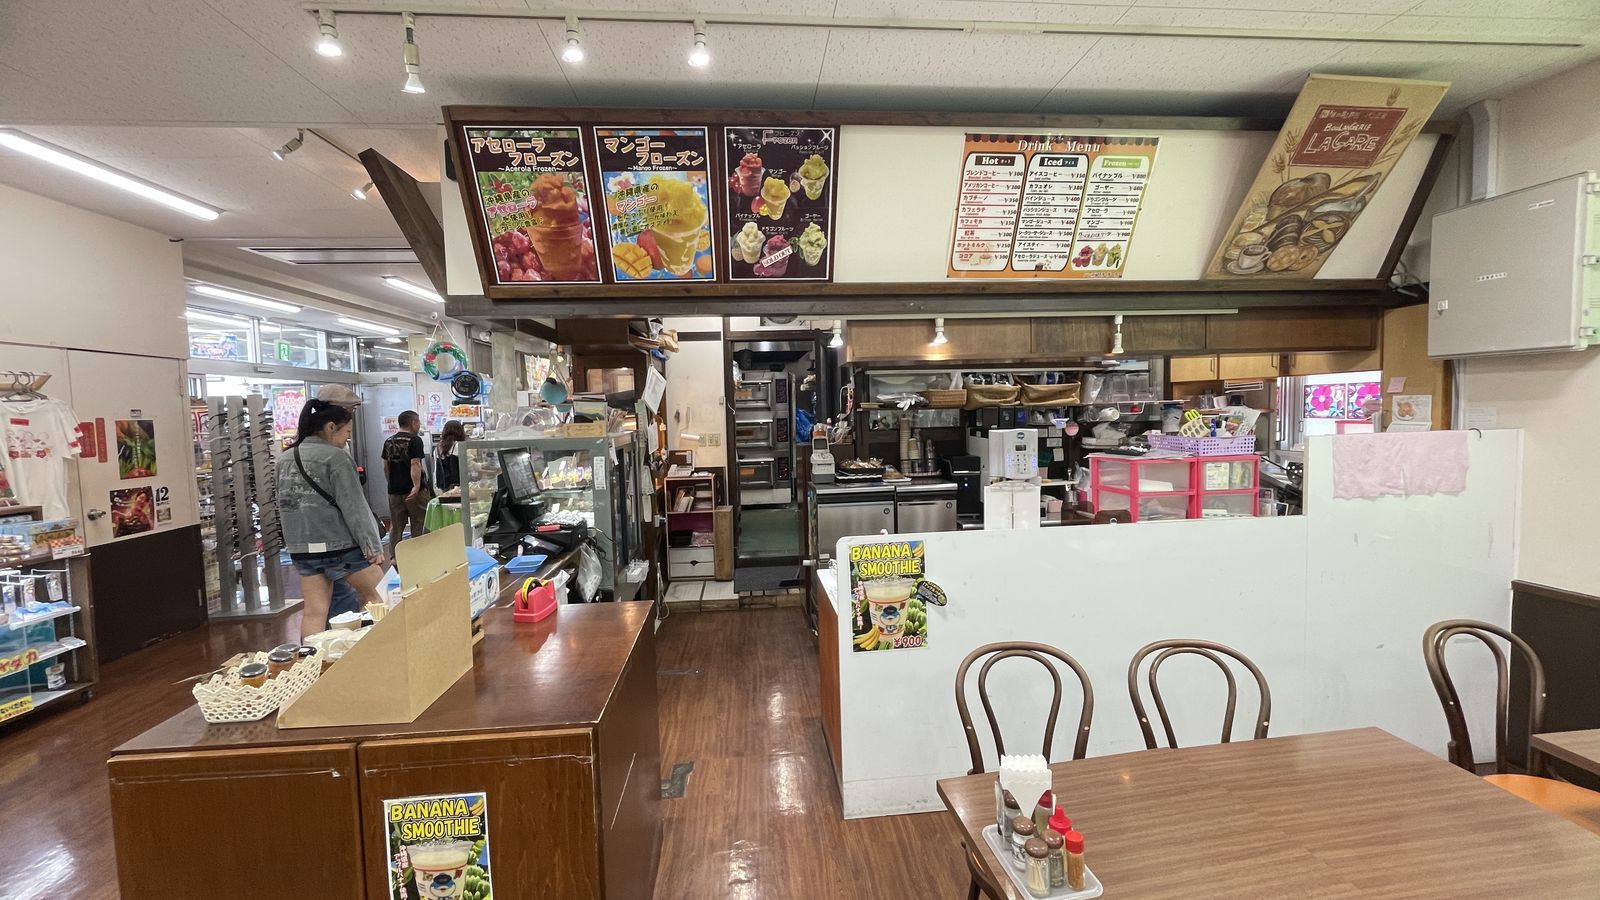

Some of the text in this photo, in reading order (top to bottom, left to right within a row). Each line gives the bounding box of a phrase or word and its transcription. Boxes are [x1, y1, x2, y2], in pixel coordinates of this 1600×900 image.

[470, 137, 546, 154] アセローラ
[604, 136, 665, 153] マンゴー
[1017, 139, 1101, 152] Drink Menu
[509, 151, 580, 167] フローズン
[636, 150, 704, 166] フローズン
[982, 157, 999, 165] Hot
[1044, 158, 1063, 166] Iced
[485, 188, 530, 205] 沖縄県産の
[616, 193, 657, 213] マンゴー
[486, 195, 538, 218] アセローラ
[155, 486, 169, 502] 12
[851, 542, 911, 560] BANANA
[860, 559, 921, 577] SMOOTHIE
[893, 635, 922, 648] ¥900
[390, 798, 469, 822] BANANA
[402, 817, 481, 841] SMOOTHIE
